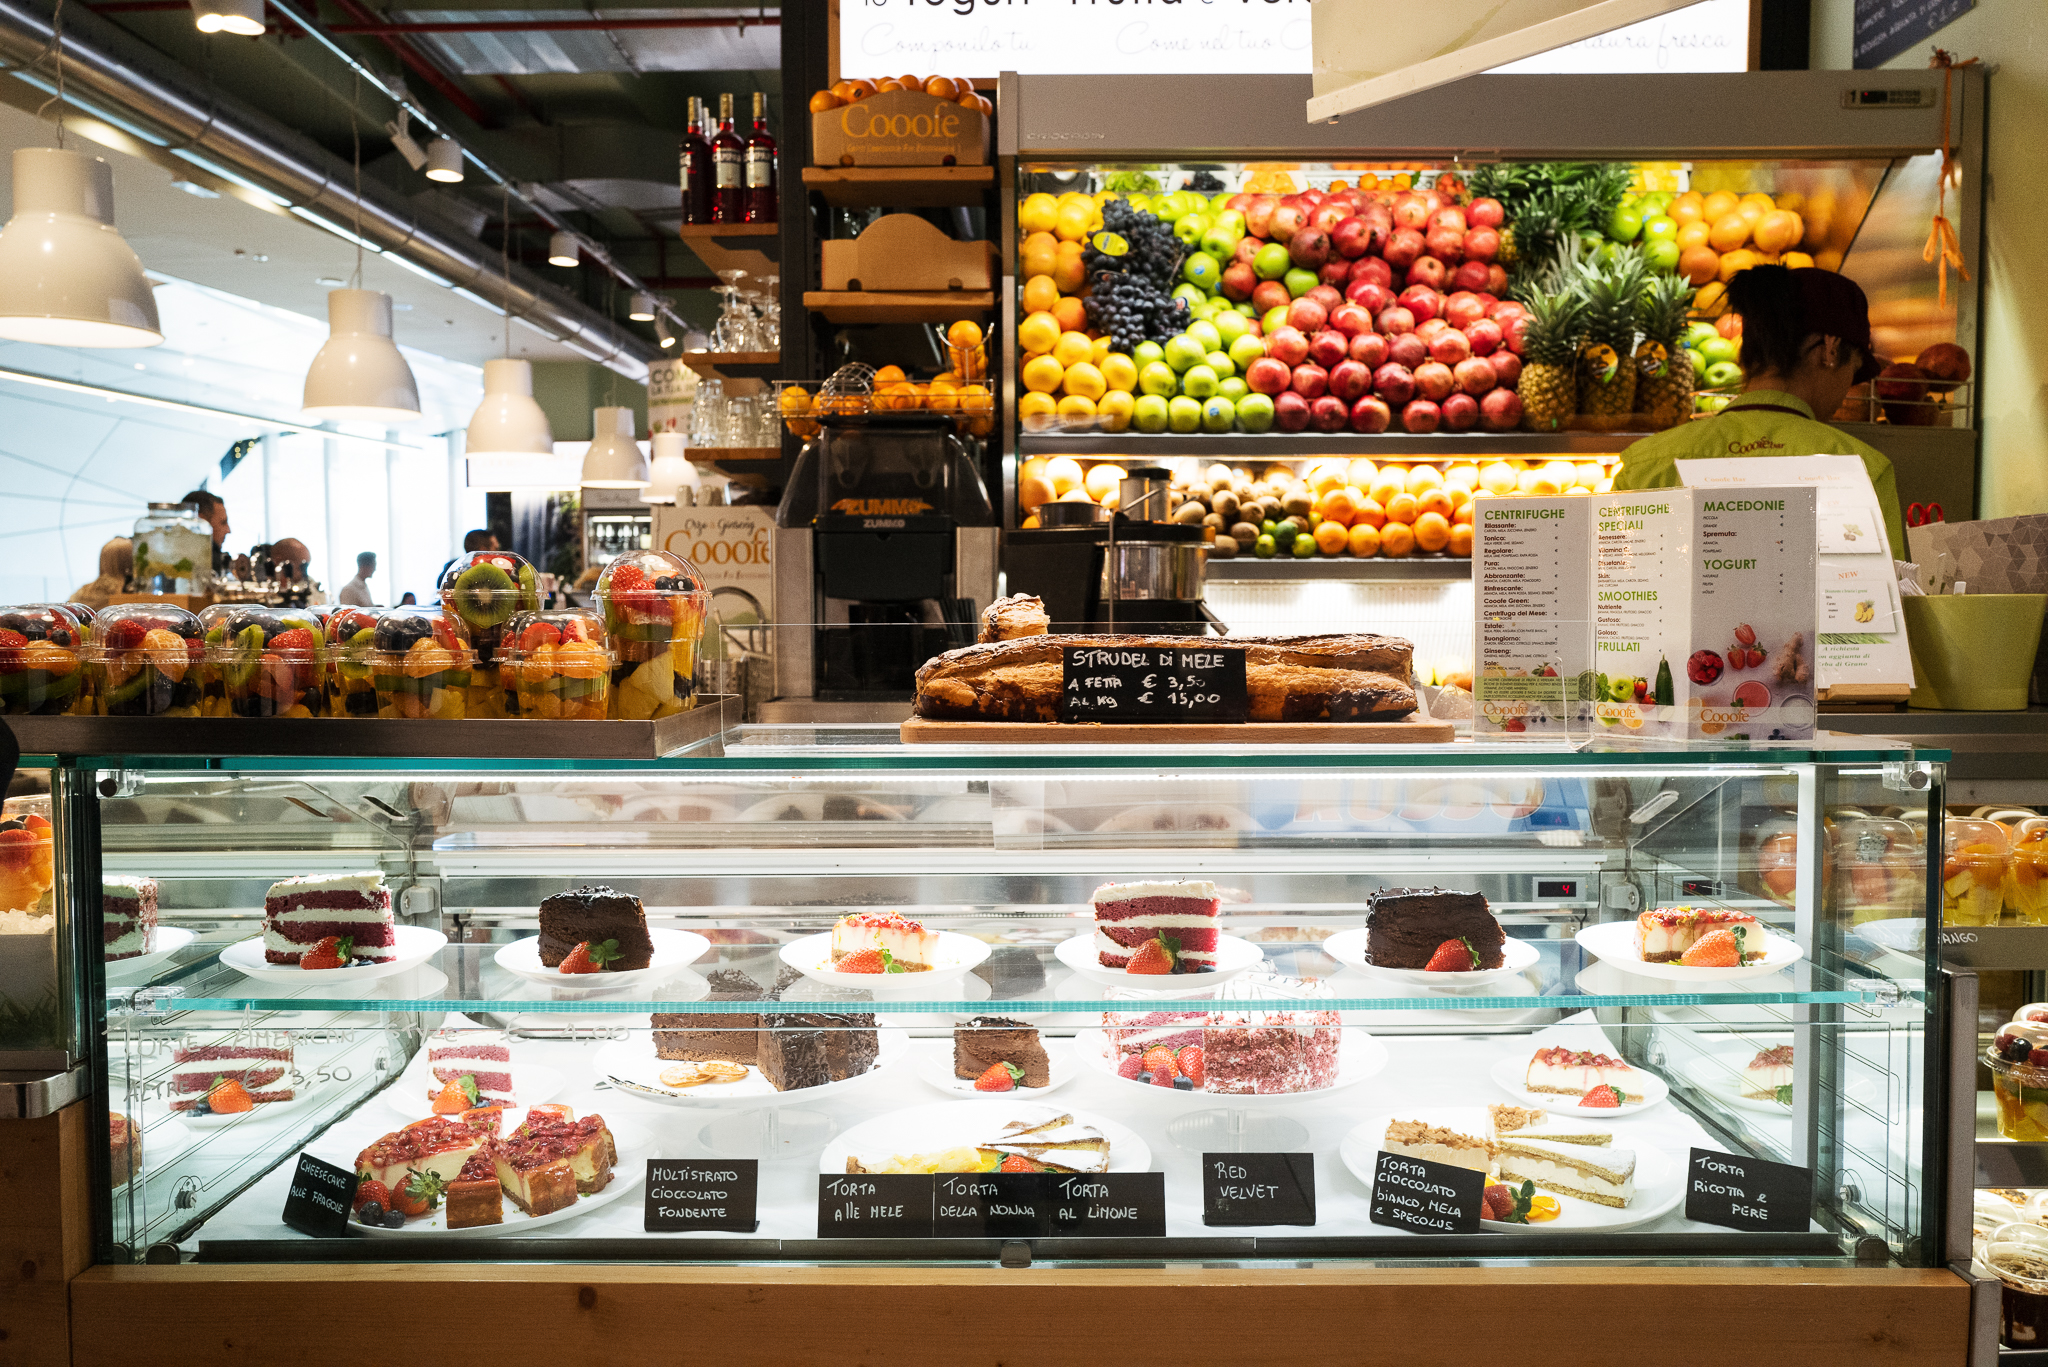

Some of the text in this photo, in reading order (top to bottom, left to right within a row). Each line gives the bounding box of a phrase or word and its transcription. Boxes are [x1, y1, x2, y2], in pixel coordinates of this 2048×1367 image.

[1115, 21, 1194, 55] Come
[842, 102, 961, 138] Cooofe
[1599, 503, 1670, 517] CENTRIFUGHE
[1703, 500, 1785, 511] MACEDONIE
[1484, 508, 1565, 520] CENTRIFUGHE
[863, 519, 906, 528] ZUMMO
[1598, 520, 1643, 532] SPECIALI
[1703, 559, 1757, 570] YOGURT
[1838, 570, 1859, 580] NEW
[1598, 591, 1658, 601] SMOOTHIES
[1597, 642, 1640, 652] FRULLATI
[1072, 649, 1150, 668] STRUDEL
[1067, 673, 1206, 691] A FETTA € 3,50
[1137, 691, 1154, 704] €
[1167, 692, 1221, 709] 15,00
[1483, 702, 1528, 715] Cooofe
[1596, 704, 1636, 718] Cooofe
[1700, 708, 1750, 722] Cooofe
[1562, 884, 1570, 894] 4
[1938, 932, 1978, 944] ANGO
[288, 1065, 353, 1090] 3,50
[300, 1159, 347, 1189] CHEESECAKE
[1213, 1161, 1247, 1179] RED
[1380, 1156, 1426, 1178] TORTA
[1695, 1155, 1746, 1178] TORTA
[826, 1178, 876, 1197] TORTA
[942, 1176, 998, 1196] TORTA
[1058, 1176, 1110, 1200] TORTA
[1220, 1184, 1279, 1200] VELVET
[290, 1185, 344, 1214] ALLE FRAGOLE
[658, 1206, 728, 1218] FONDENTE
[870, 1205, 904, 1218] MELE
[939, 1203, 1036, 1218] DELLA NONNA
[1058, 1207, 1077, 1220] AL
[1428, 1199, 1462, 1219] MELA
[1731, 1203, 1769, 1220] PERE
[1392, 1208, 1455, 1231] SPECOLUS
